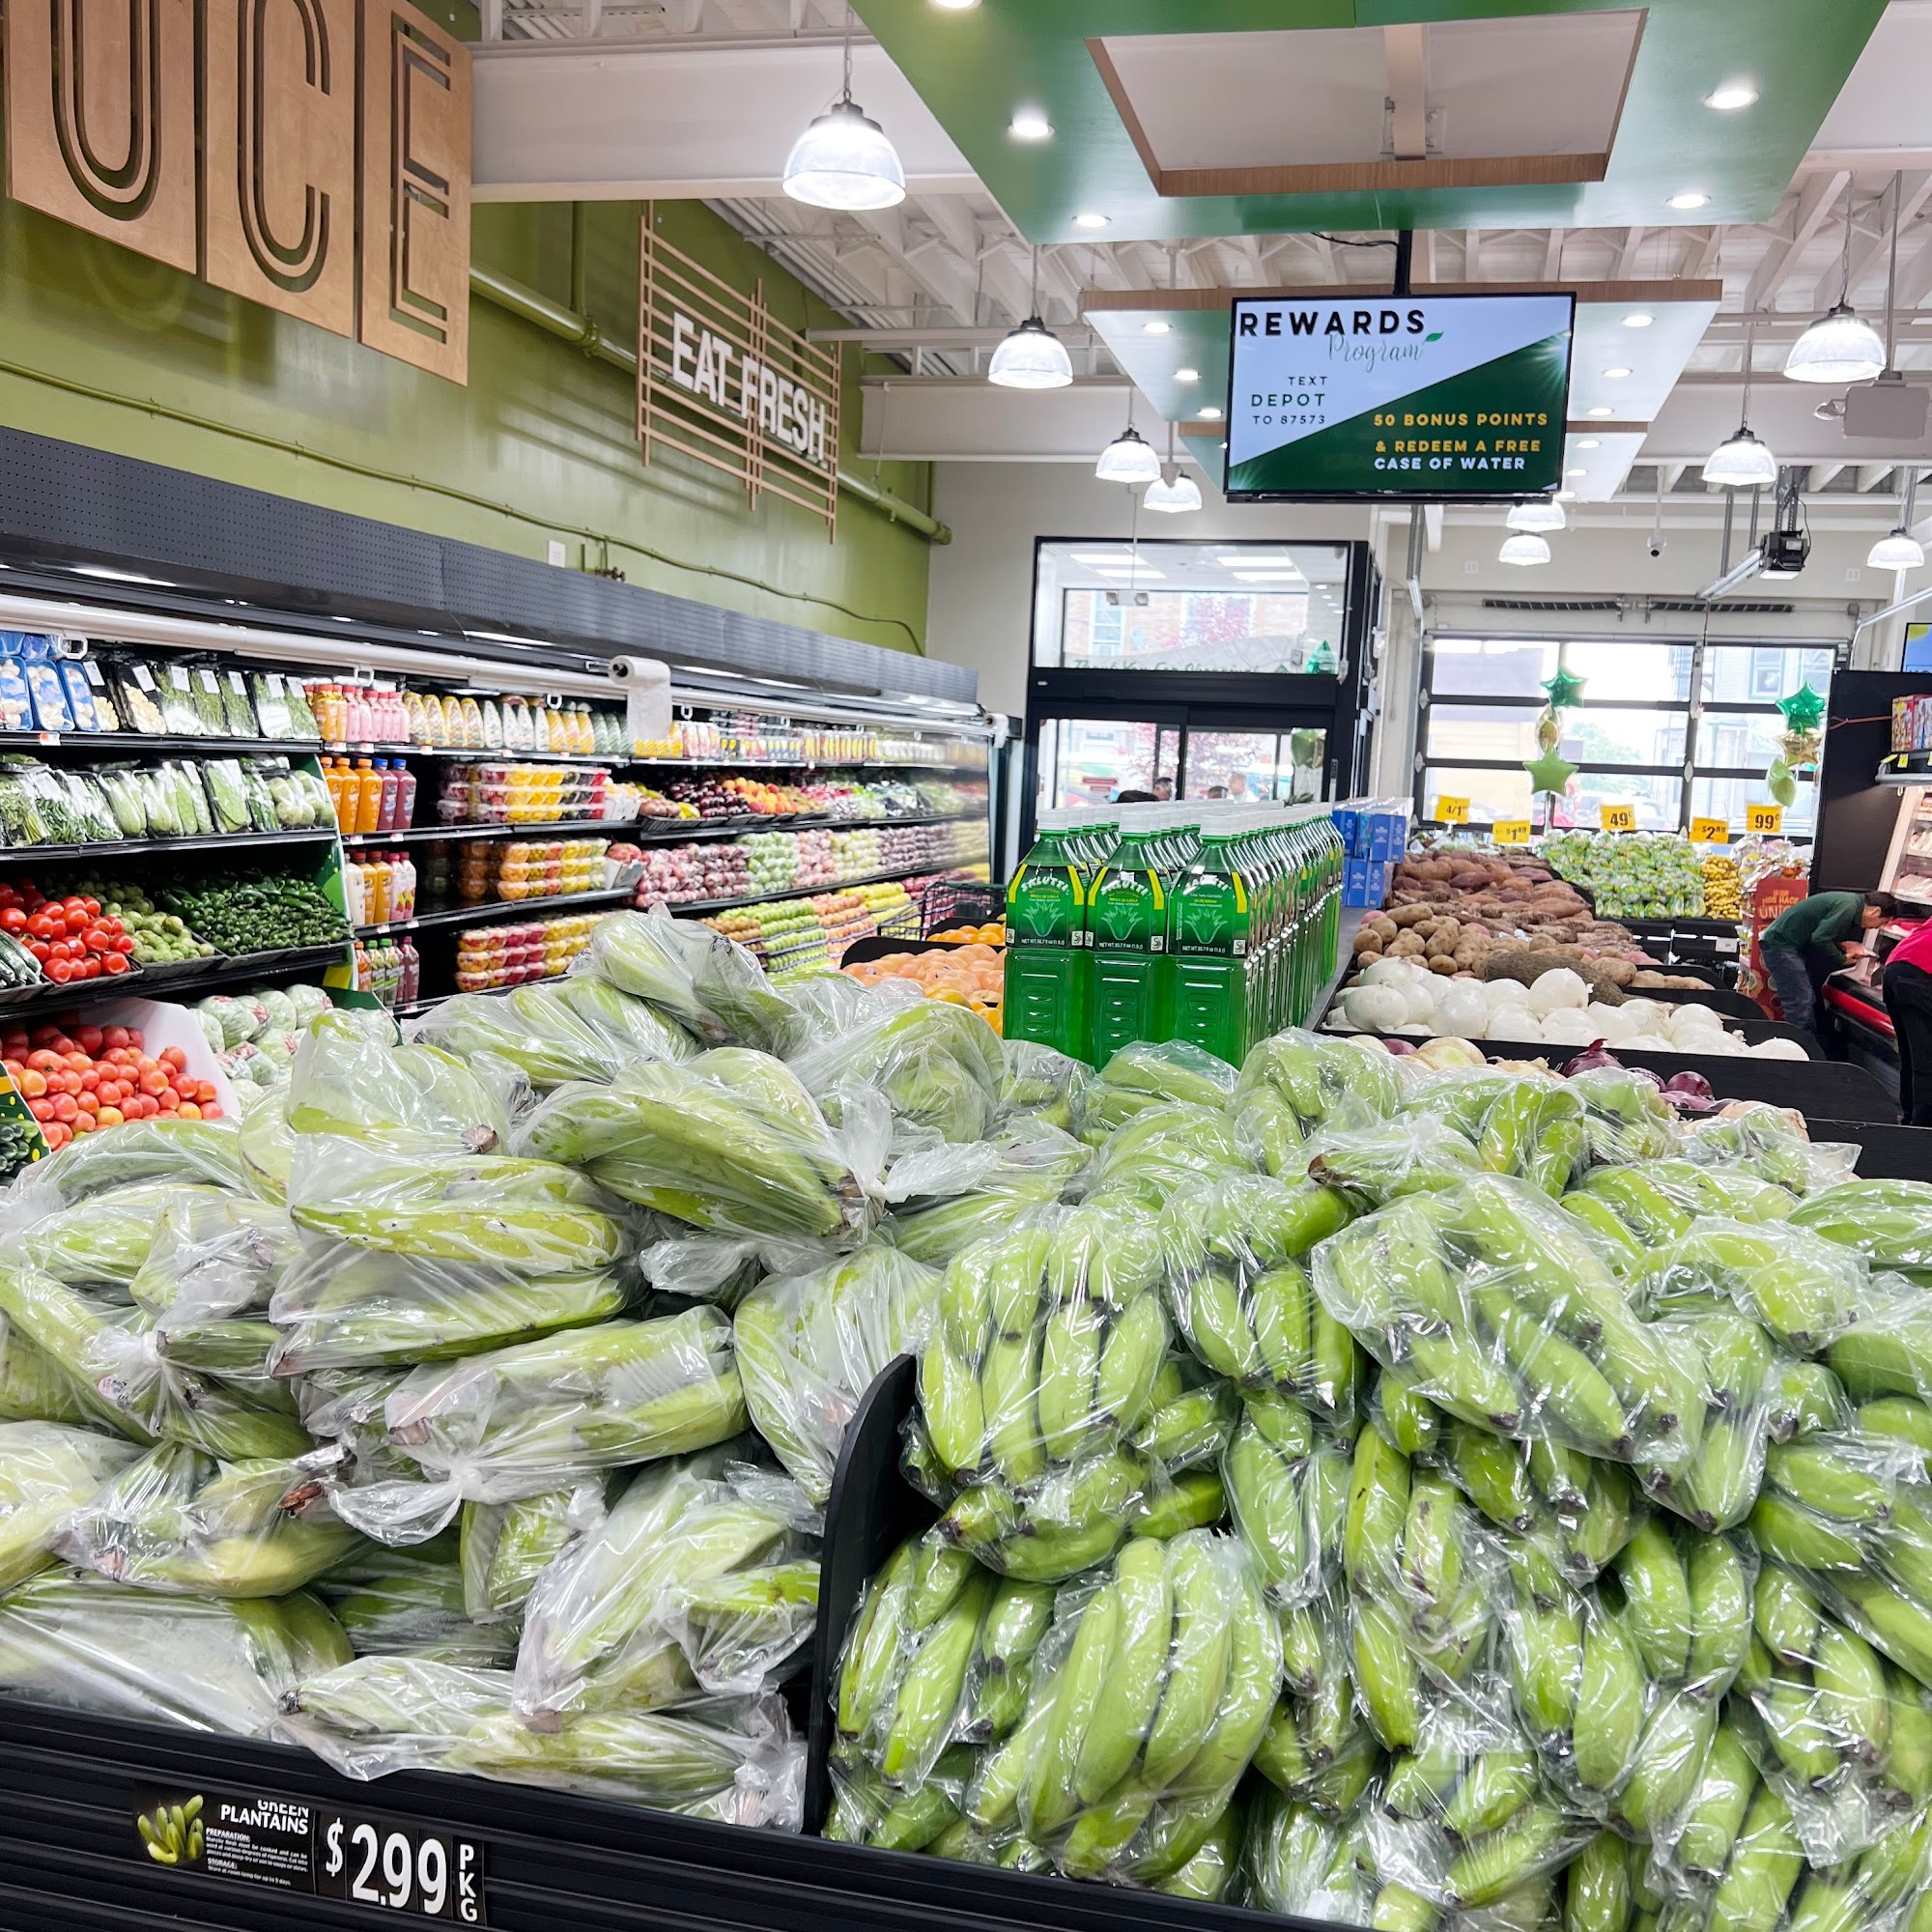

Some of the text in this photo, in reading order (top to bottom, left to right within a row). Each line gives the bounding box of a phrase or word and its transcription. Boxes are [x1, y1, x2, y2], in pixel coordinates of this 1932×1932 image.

[1240, 309, 1425, 336] REWARDS
[1329, 334, 1423, 373] Program
[673, 311, 826, 462] EAT FRESH
[1288, 376, 1328, 385] TEXT
[1251, 393, 1325, 407] DEPOT
[1253, 414, 1325, 425] TO 87573
[1374, 412, 1548, 427] 50 BONUS POINTS
[1375, 440, 1541, 452] & REDEEM A FREE
[1374, 457, 1525, 469] CASE OF WATER
[220, 1804, 308, 1835] PLANTAINS
[327, 1817, 446, 1915] $2.99
